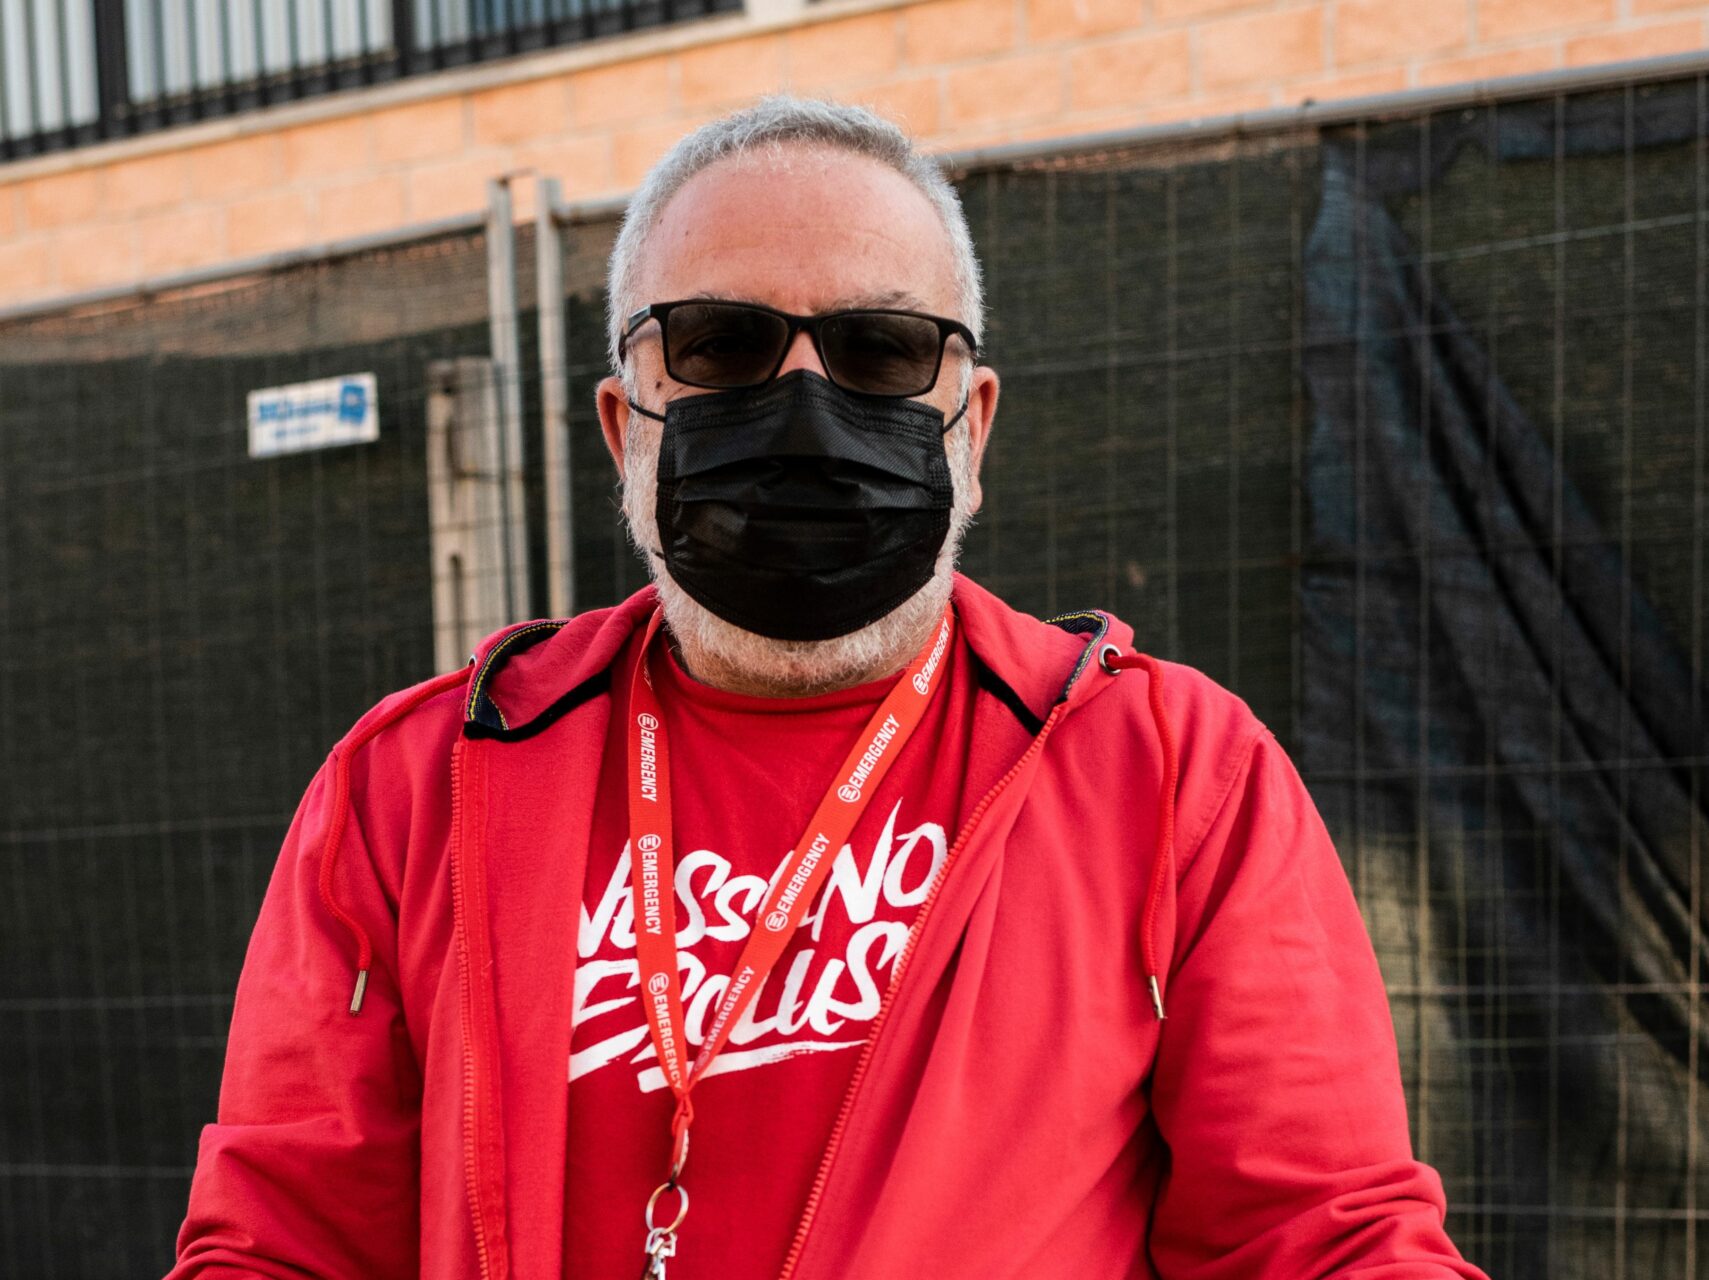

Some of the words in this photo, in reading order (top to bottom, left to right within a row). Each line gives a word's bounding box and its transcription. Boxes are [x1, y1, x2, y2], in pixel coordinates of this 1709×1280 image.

[921, 616, 951, 682] EMERGENCY
[640, 728, 658, 803] EMERGENCY
[847, 713, 901, 788] EMERGENCY
[642, 851, 662, 935] EMERGENCY
[779, 832, 830, 914] EMERGENCY
[654, 994, 682, 1089] EMERGENCY
[704, 965, 755, 1051] EMERGENCY
